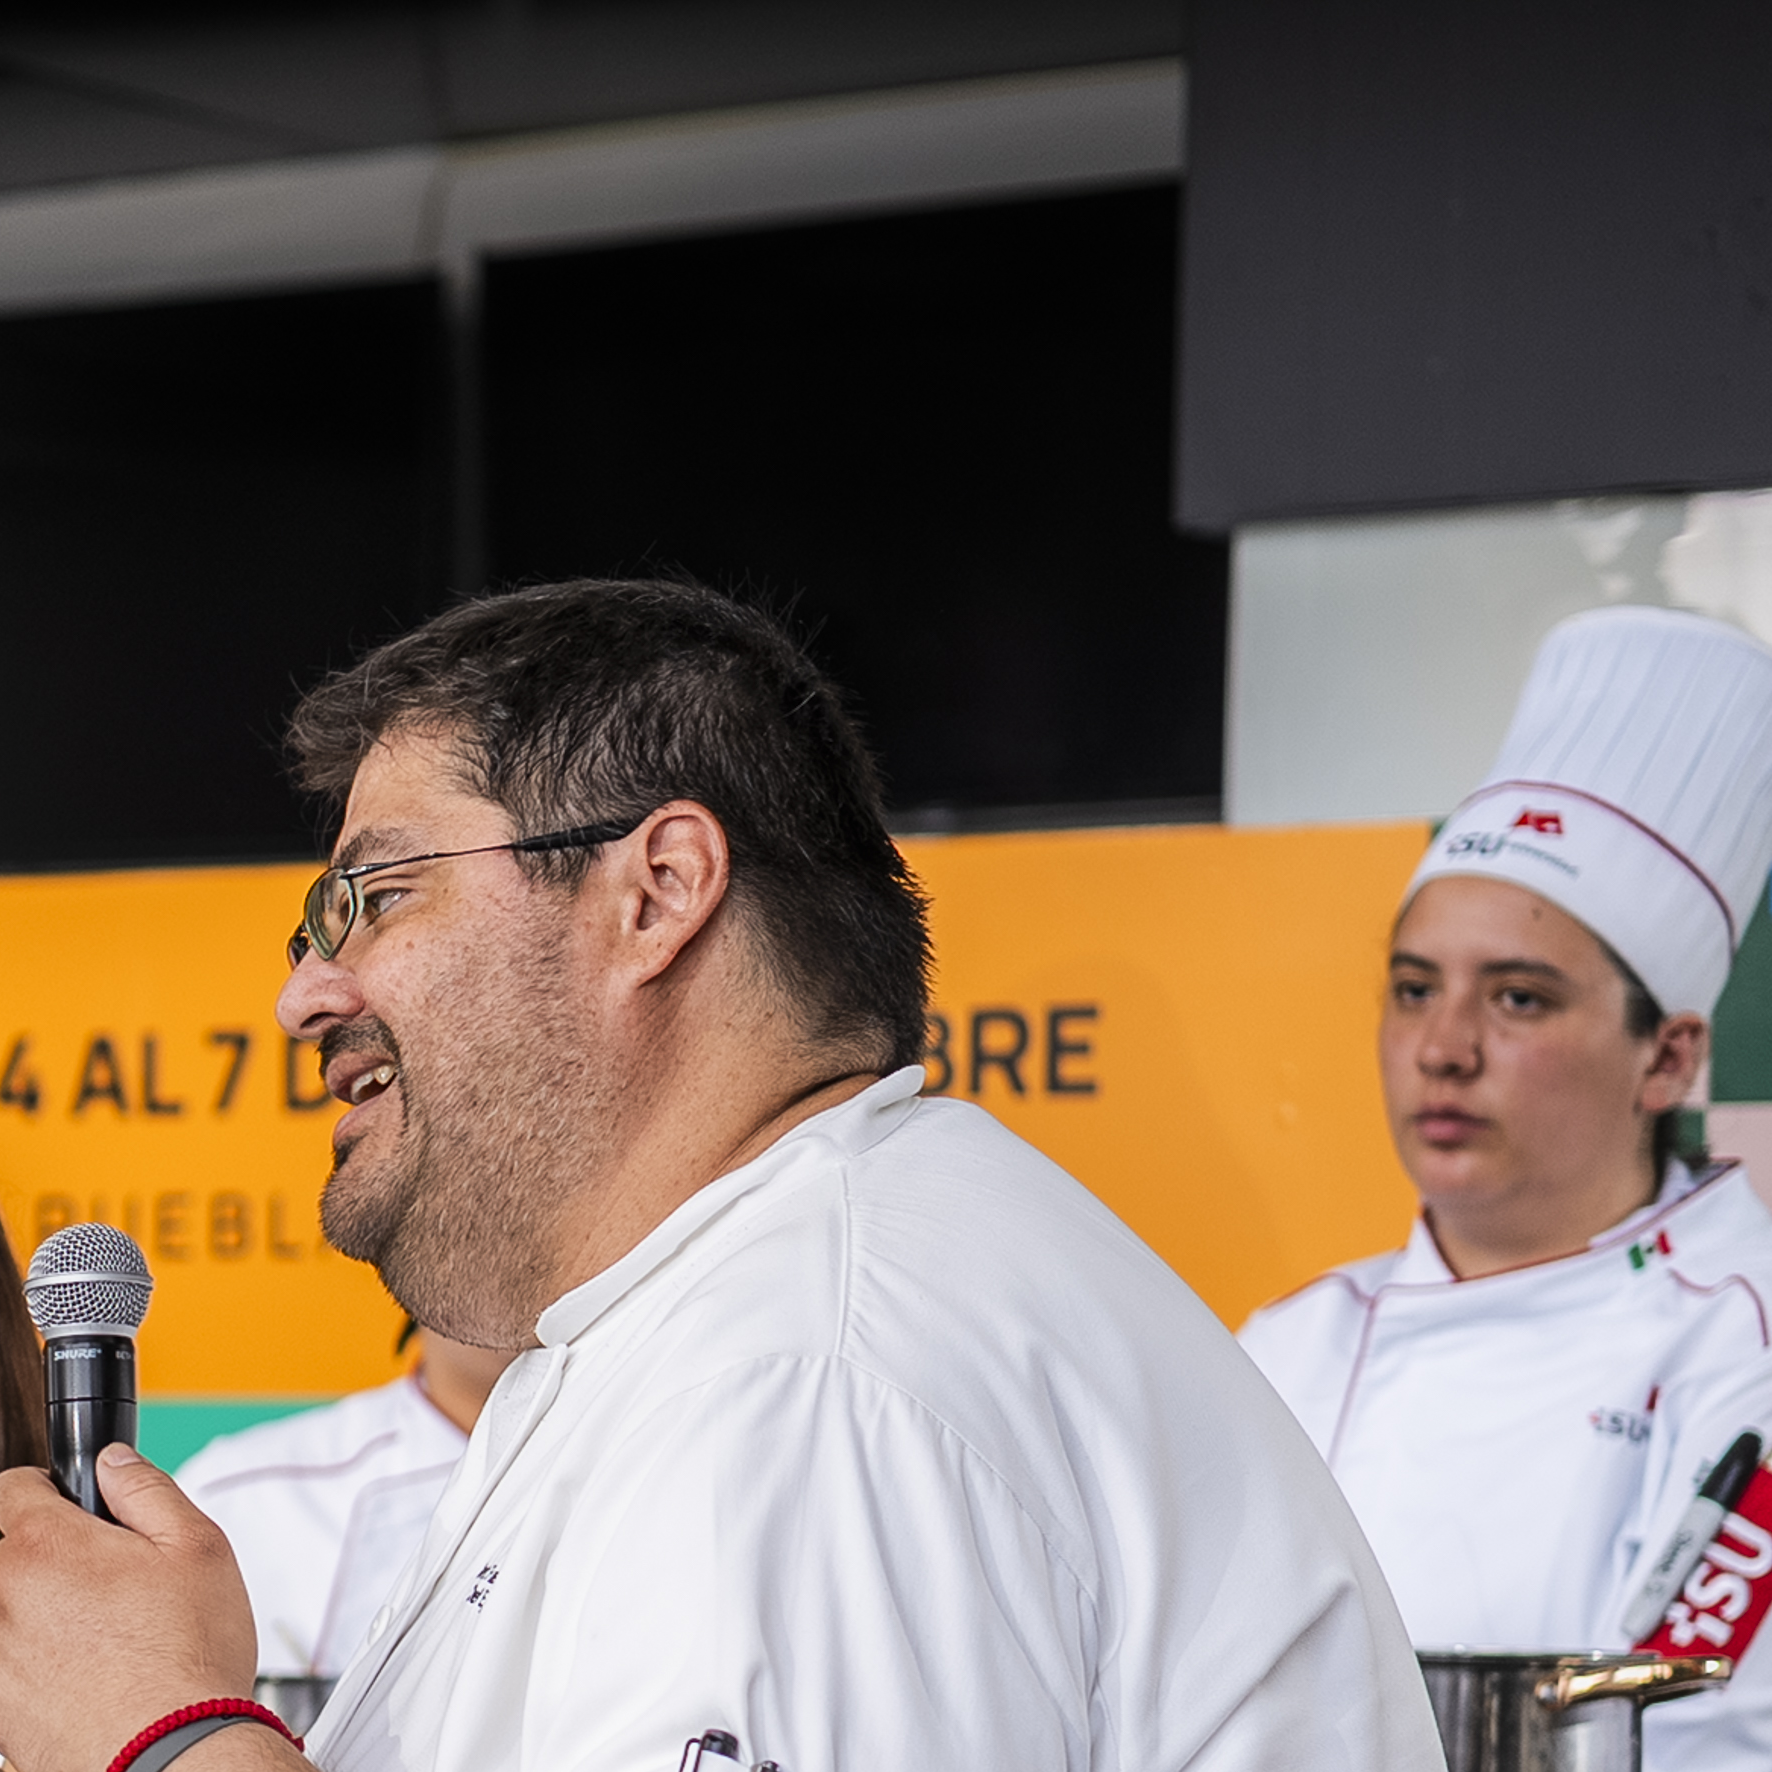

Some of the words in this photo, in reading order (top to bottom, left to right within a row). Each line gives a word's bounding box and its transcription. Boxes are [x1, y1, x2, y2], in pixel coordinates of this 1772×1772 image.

[71, 1033, 179, 1118] AL
[208, 1031, 251, 1114] 7
[923, 1003, 1100, 1096] BRE
[35, 1190, 317, 1263] PUEBL
